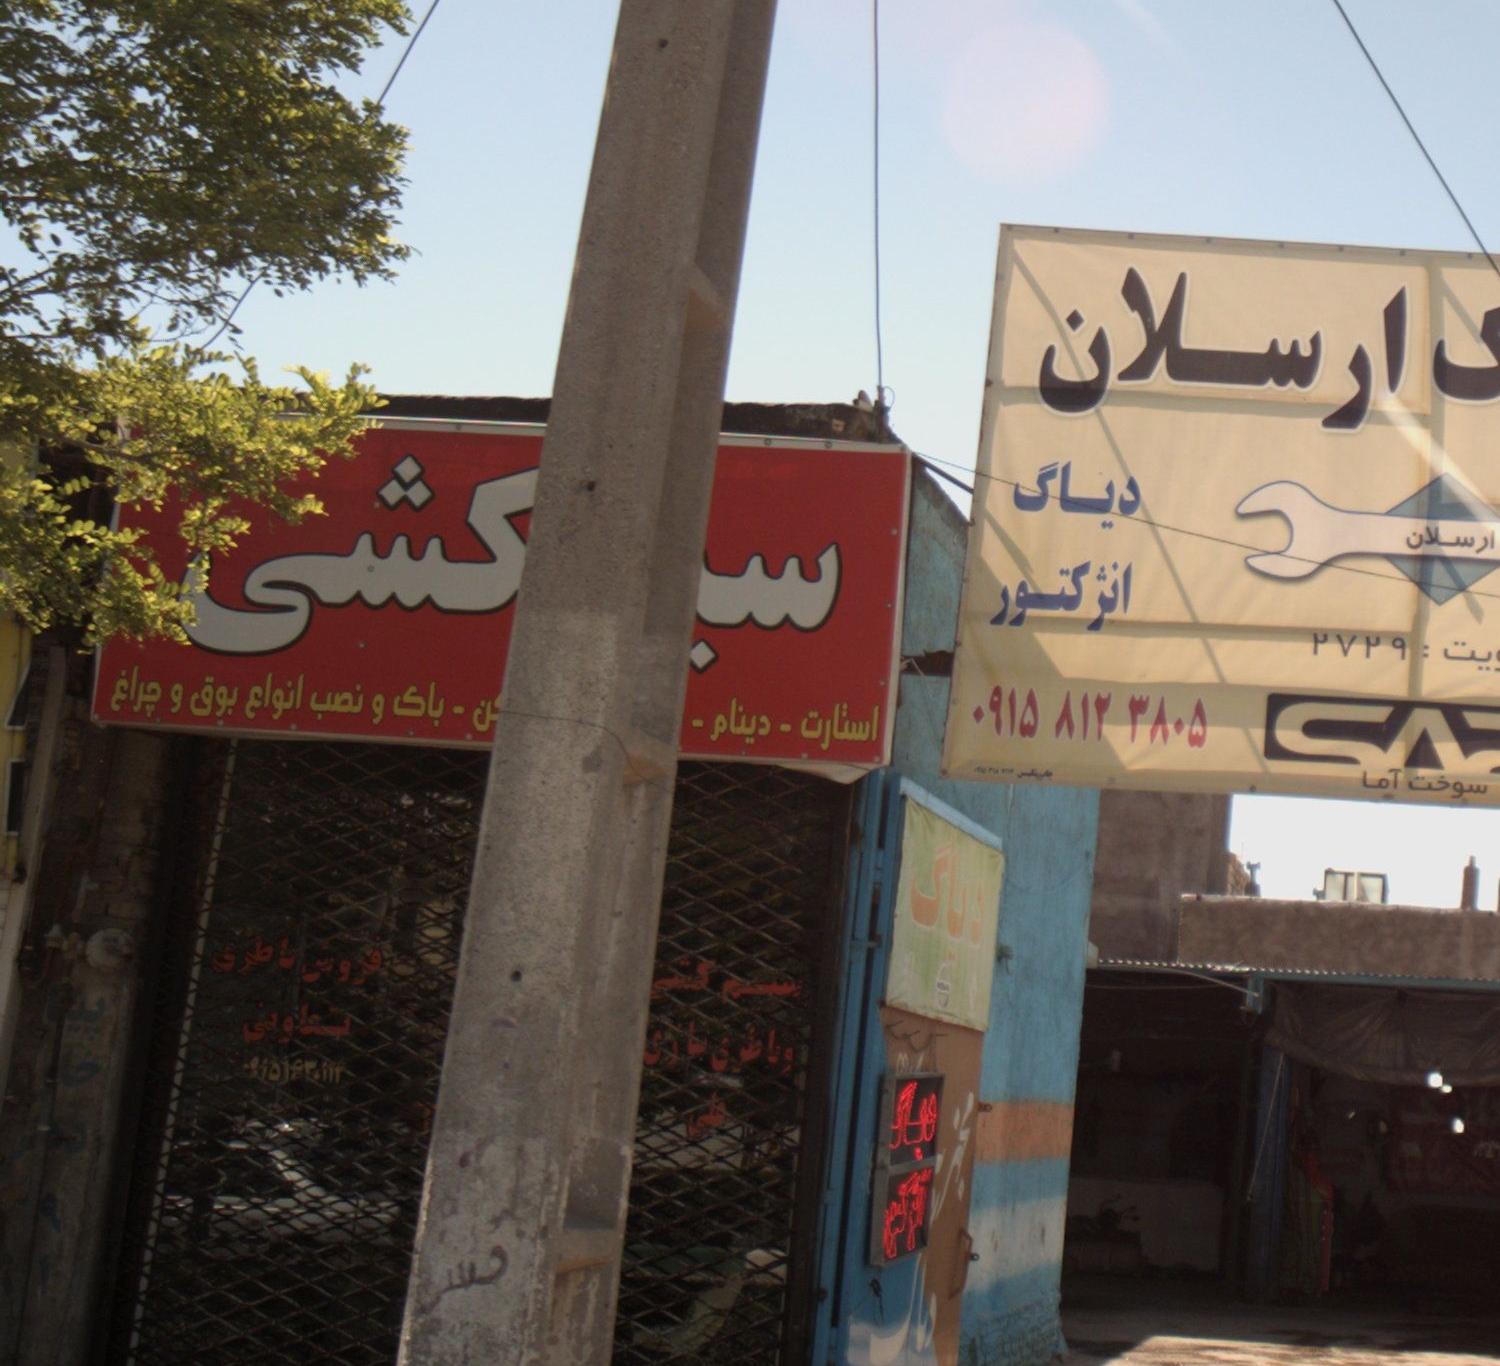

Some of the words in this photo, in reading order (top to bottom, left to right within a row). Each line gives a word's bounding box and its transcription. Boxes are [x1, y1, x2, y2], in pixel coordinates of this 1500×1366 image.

[1038, 266, 1407, 430] ارسلان
[1013, 460, 1142, 530] دیاگ
[1405, 525, 1495, 554] ارسلان
[989, 559, 1133, 631] انژکتور
[1312, 632, 1407, 662] ۲۷۲۹
[109, 666, 162, 717] چراغ
[169, 682, 183, 708] و
[189, 675, 239, 718] بوق
[244, 672, 304, 720] انواع
[309, 683, 365, 717] نصب
[371, 693, 385, 725] و
[393, 681, 446, 728] باک
[709, 697, 772, 745] دینام
[800, 702, 880, 751] استارت
[972, 684, 1040, 739] ۰۹۱۵
[1054, 689, 1113, 742] ۸۱۲
[1127, 693, 1208, 749] ۳۸۰۵
[1362, 768, 1403, 791] آما
[1407, 775, 1489, 799] سوخت
